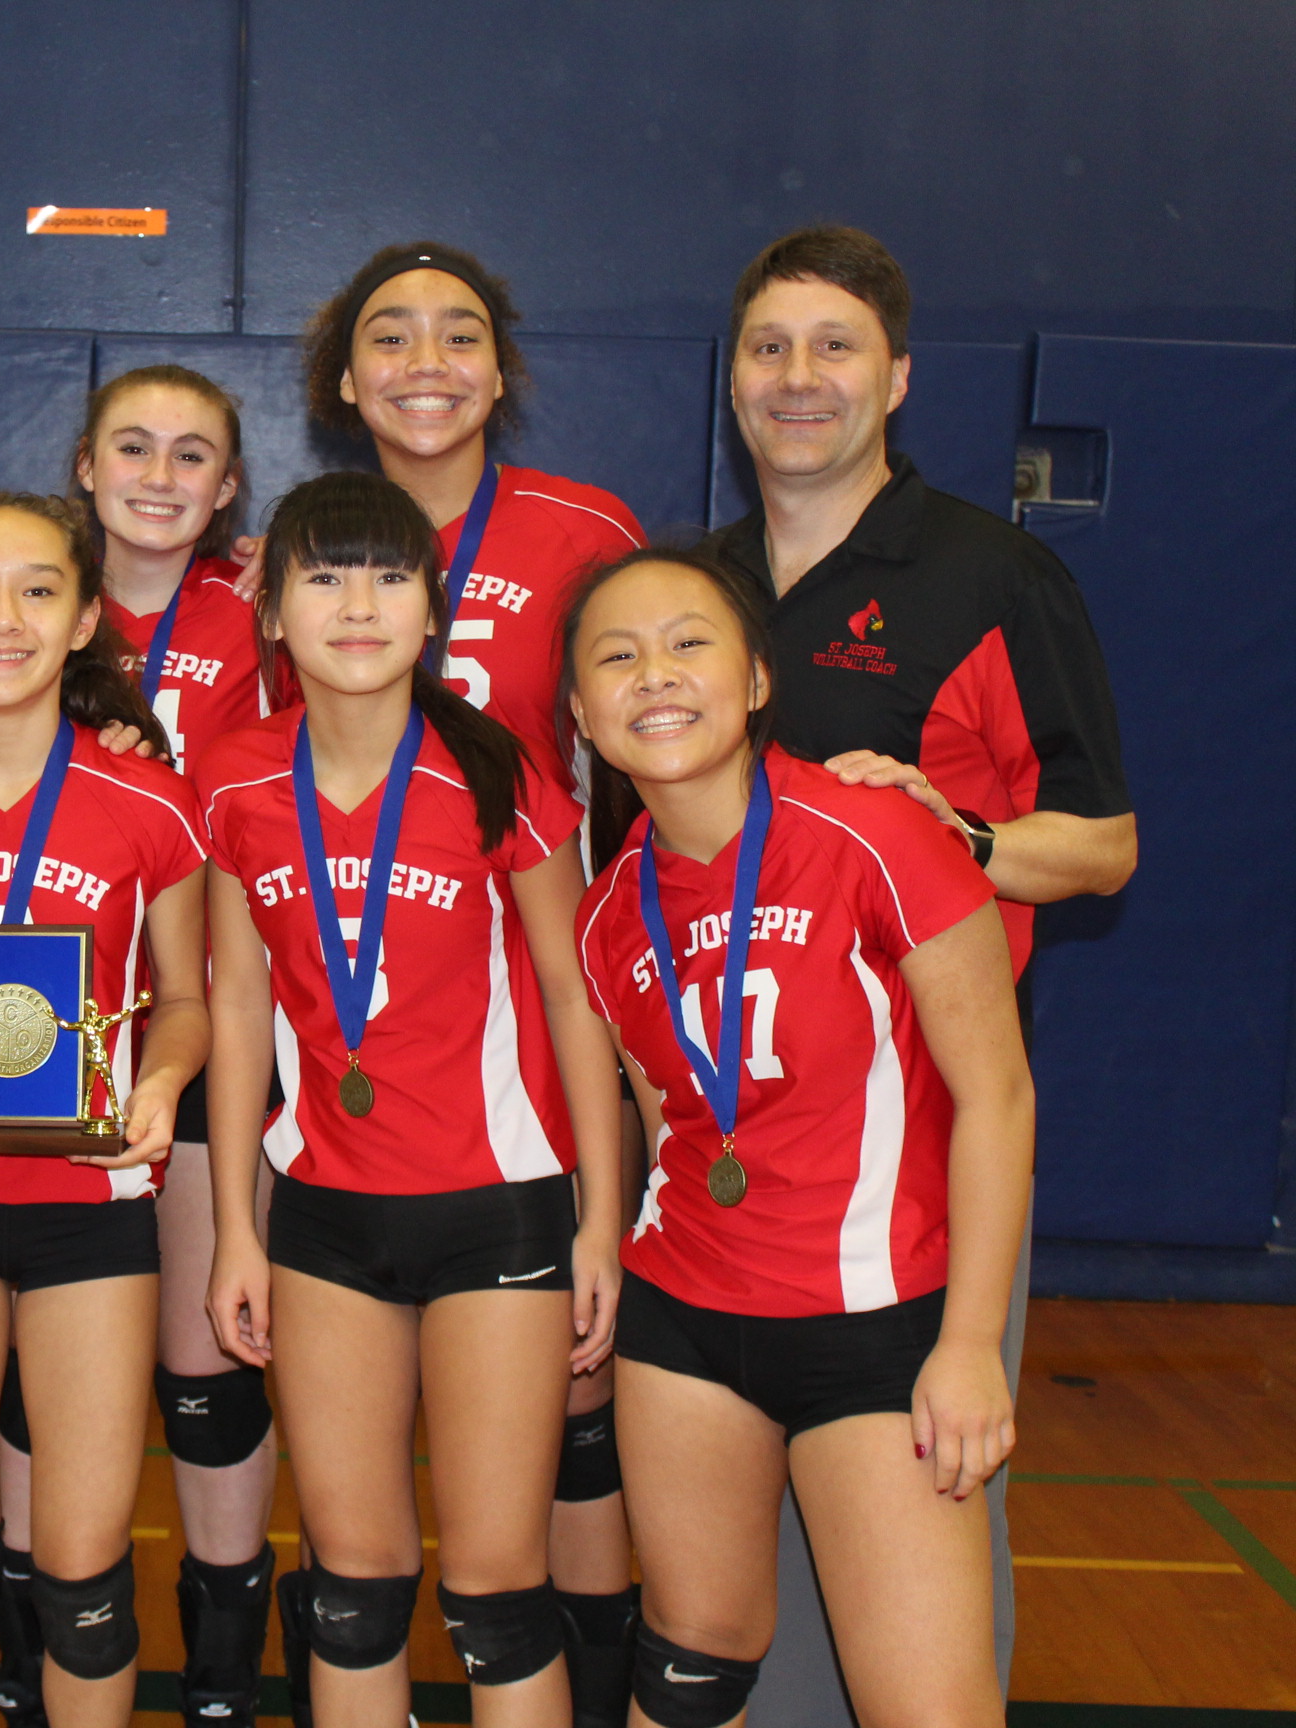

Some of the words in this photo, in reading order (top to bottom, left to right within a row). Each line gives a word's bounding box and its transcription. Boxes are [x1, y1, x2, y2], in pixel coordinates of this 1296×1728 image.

[107, 215, 147, 228] Citizen
[828, 642, 843, 654] ST
[844, 643, 887, 660] JOSEPH
[865, 660, 898, 676] COACH
[255, 865, 307, 907] ST.
